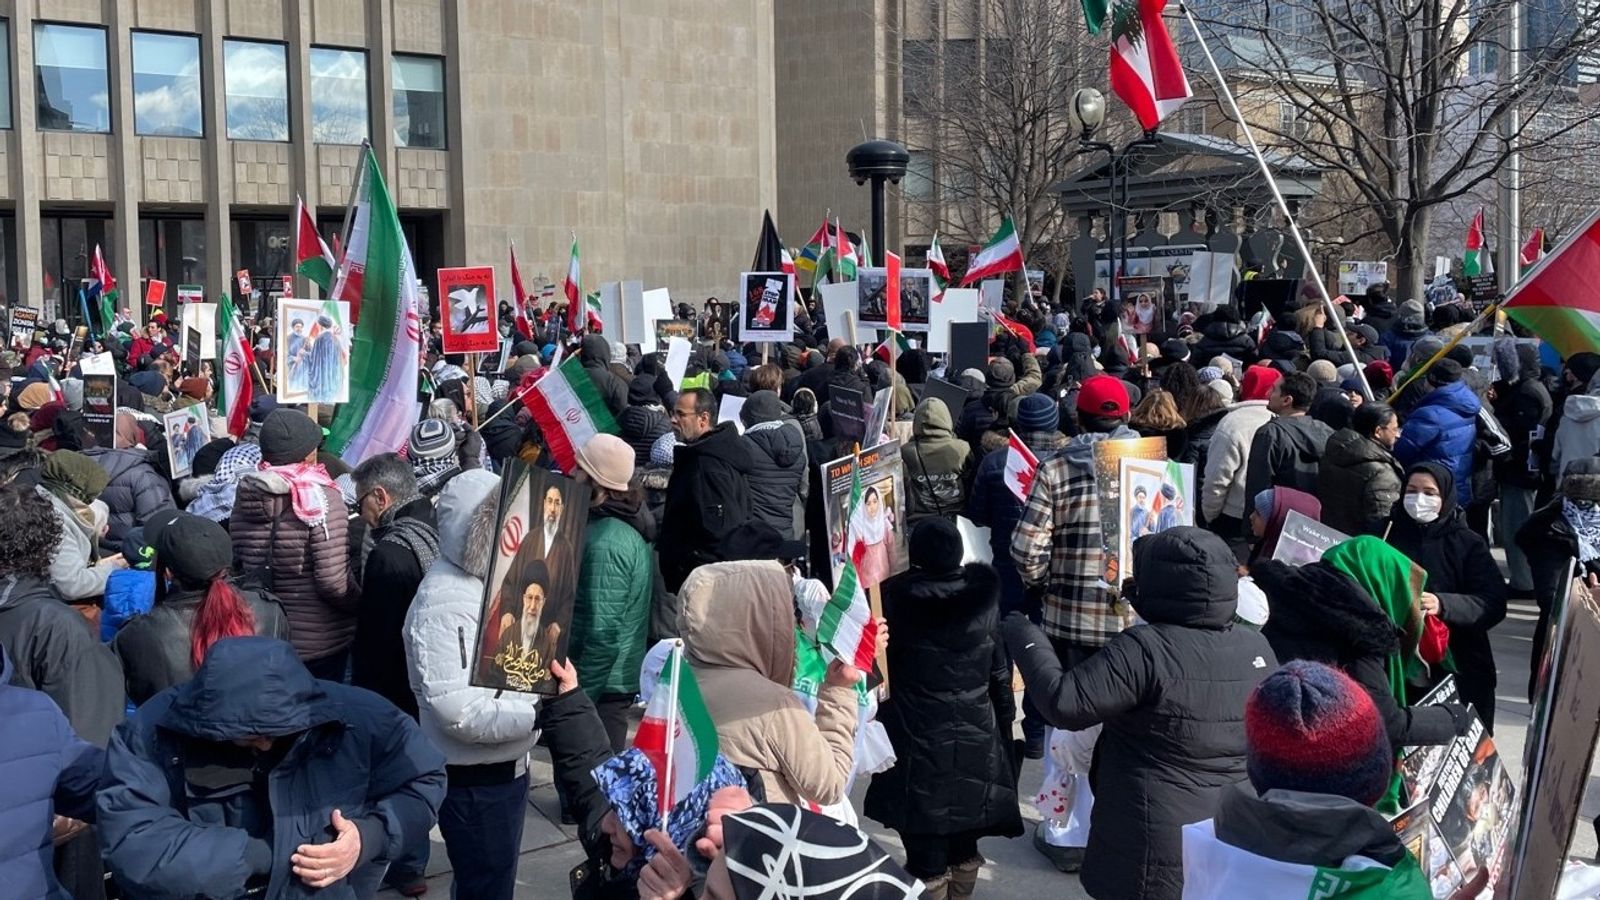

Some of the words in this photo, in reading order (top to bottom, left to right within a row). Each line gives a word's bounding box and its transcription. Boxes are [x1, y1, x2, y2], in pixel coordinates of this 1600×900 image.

[831, 467, 841, 479] TO
[1464, 717, 1484, 754] GAZA
[1458, 749, 1472, 769] OF
[1431, 761, 1465, 824] CHILDREN
